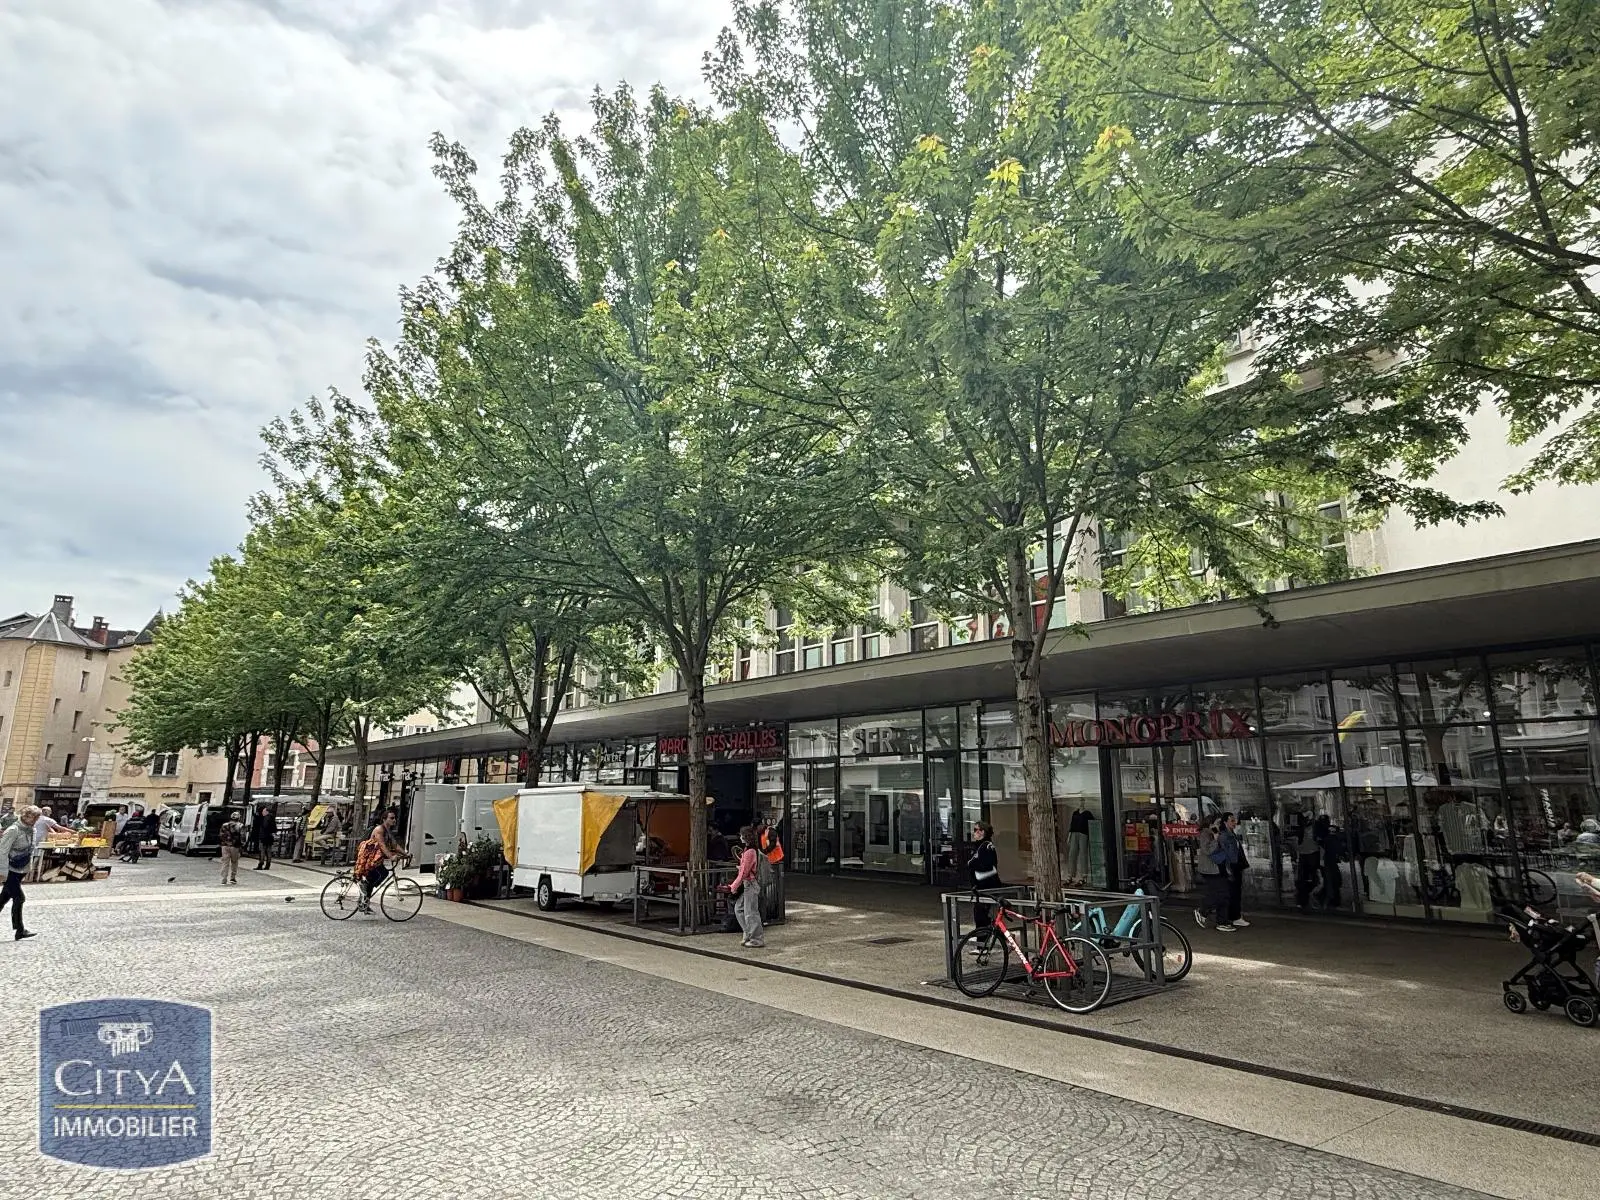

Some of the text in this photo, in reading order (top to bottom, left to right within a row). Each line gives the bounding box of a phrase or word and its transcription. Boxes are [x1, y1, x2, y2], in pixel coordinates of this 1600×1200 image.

[852, 727, 894, 754] SFR
[1050, 708, 1252, 747] MONOPRIX
[660, 729, 777, 754] MARC DES HALLES
